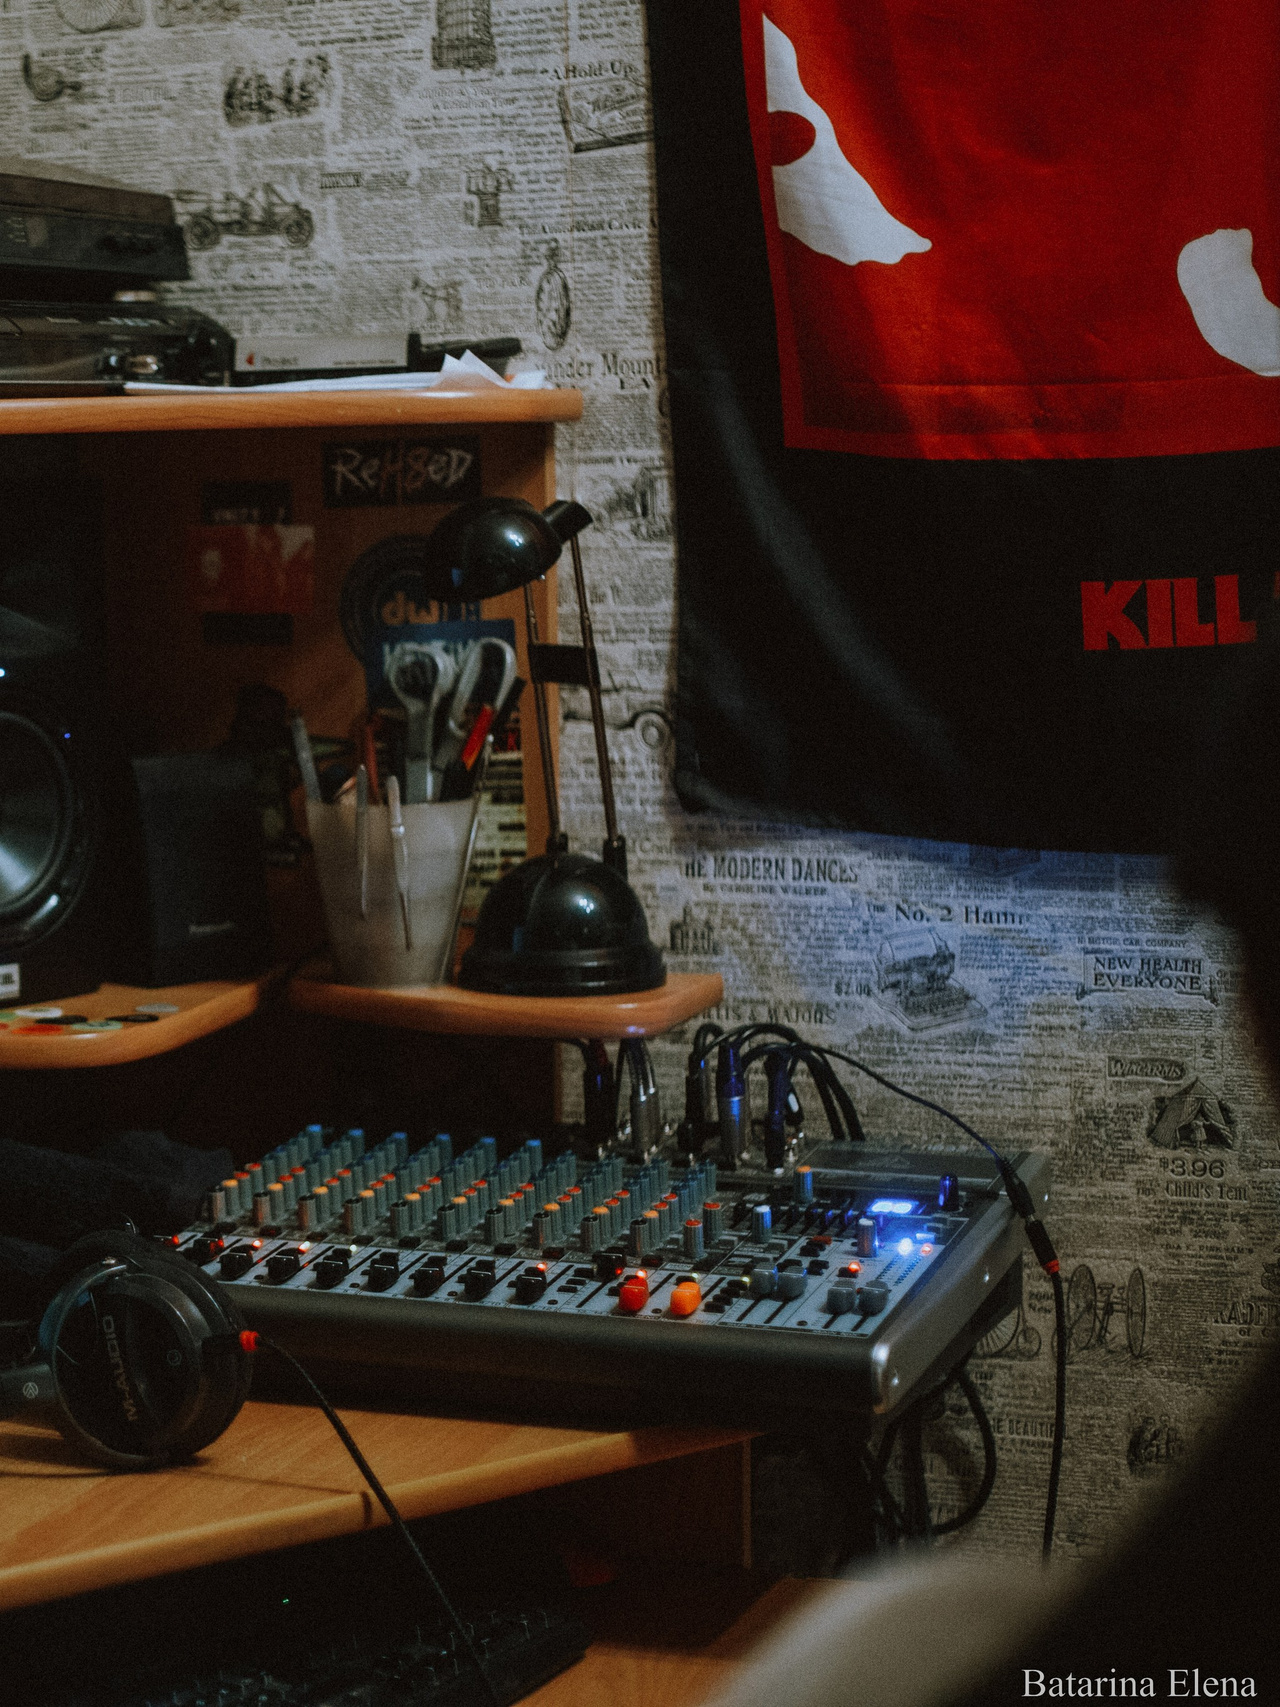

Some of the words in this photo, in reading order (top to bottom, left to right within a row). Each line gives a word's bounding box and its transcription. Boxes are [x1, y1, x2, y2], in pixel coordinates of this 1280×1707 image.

[1081, 574, 1258, 652] KILL
[713, 857, 786, 881] MODERN
[791, 861, 859, 884] DANCES
[1094, 956, 1133, 971] NEW
[1140, 958, 1202, 975] HEALTH
[1093, 973, 1200, 990] EVERYONE
[1165, 1181, 1211, 1198] Child's
[102, 1314, 139, 1422] M-AUDIO
